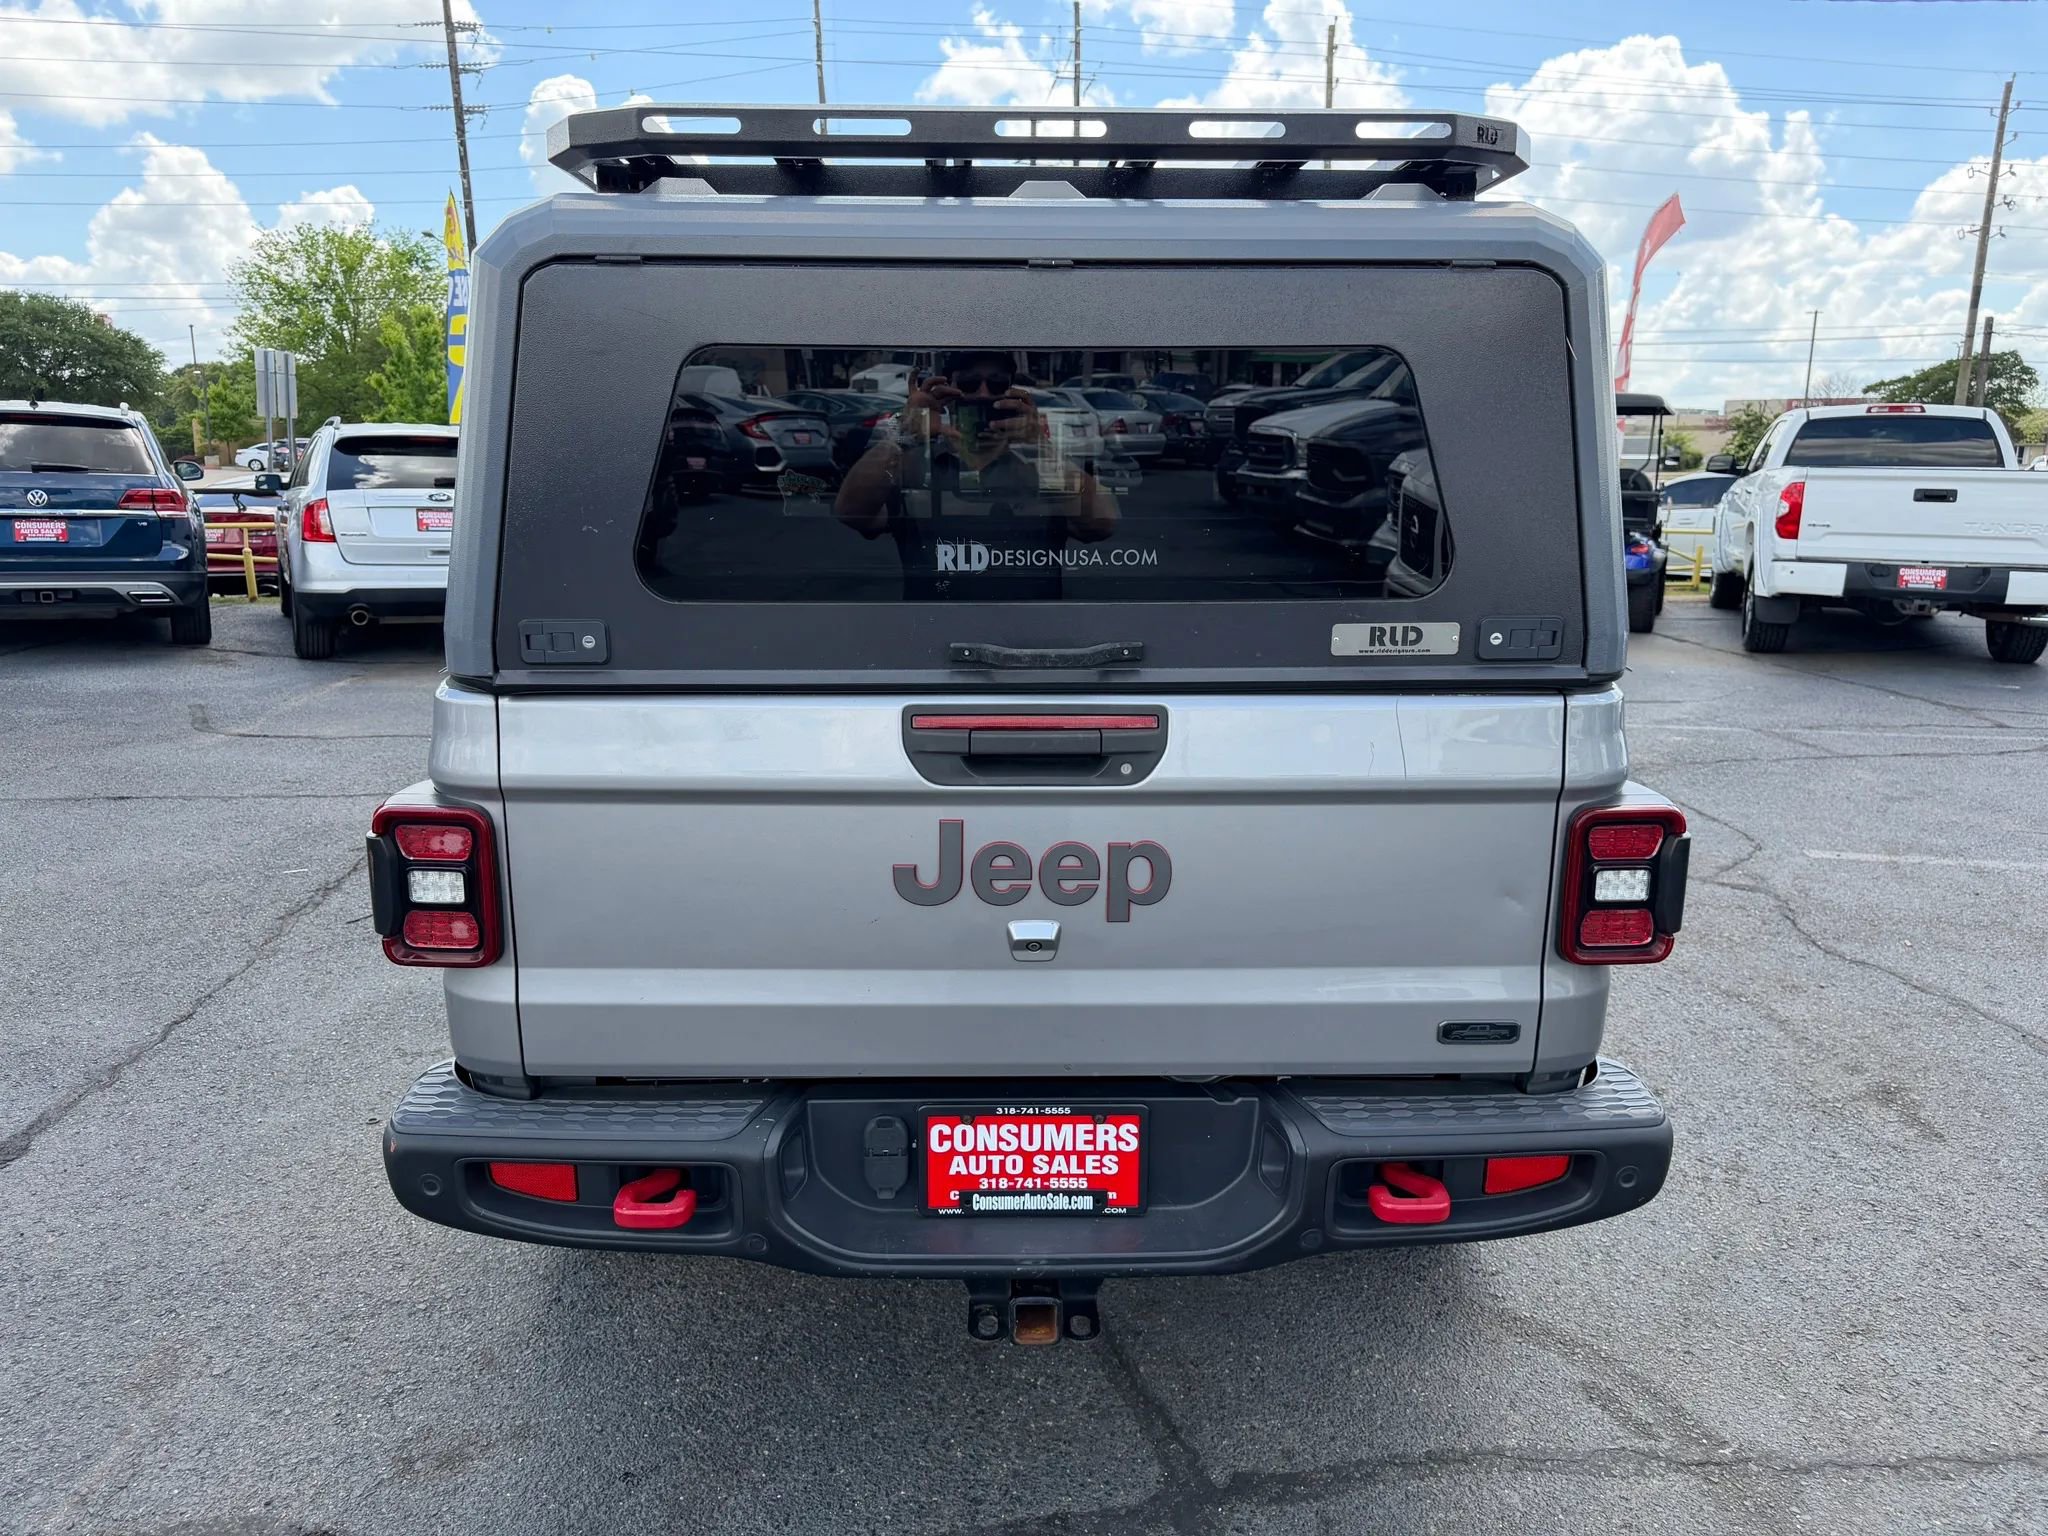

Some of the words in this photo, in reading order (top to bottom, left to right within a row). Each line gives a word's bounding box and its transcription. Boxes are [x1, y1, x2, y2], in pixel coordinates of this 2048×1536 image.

[14, 520, 66, 529] CONSUMERS
[1963, 521, 2048, 536] TUNDR
[1899, 567, 1947, 577] CONSUMERS
[1368, 625, 1424, 647] RLD
[892, 818, 1173, 923] Jeep
[995, 1107, 1072, 1115] 318-741-5555
[929, 1123, 1139, 1153] CONSUMERS
[949, 1155, 1024, 1175] AUTO
[1032, 1155, 1119, 1175] SALES
[978, 1177, 1088, 1189] 318-741-5555
[972, 1193, 1094, 1211] ConsumerAutoSale.com
